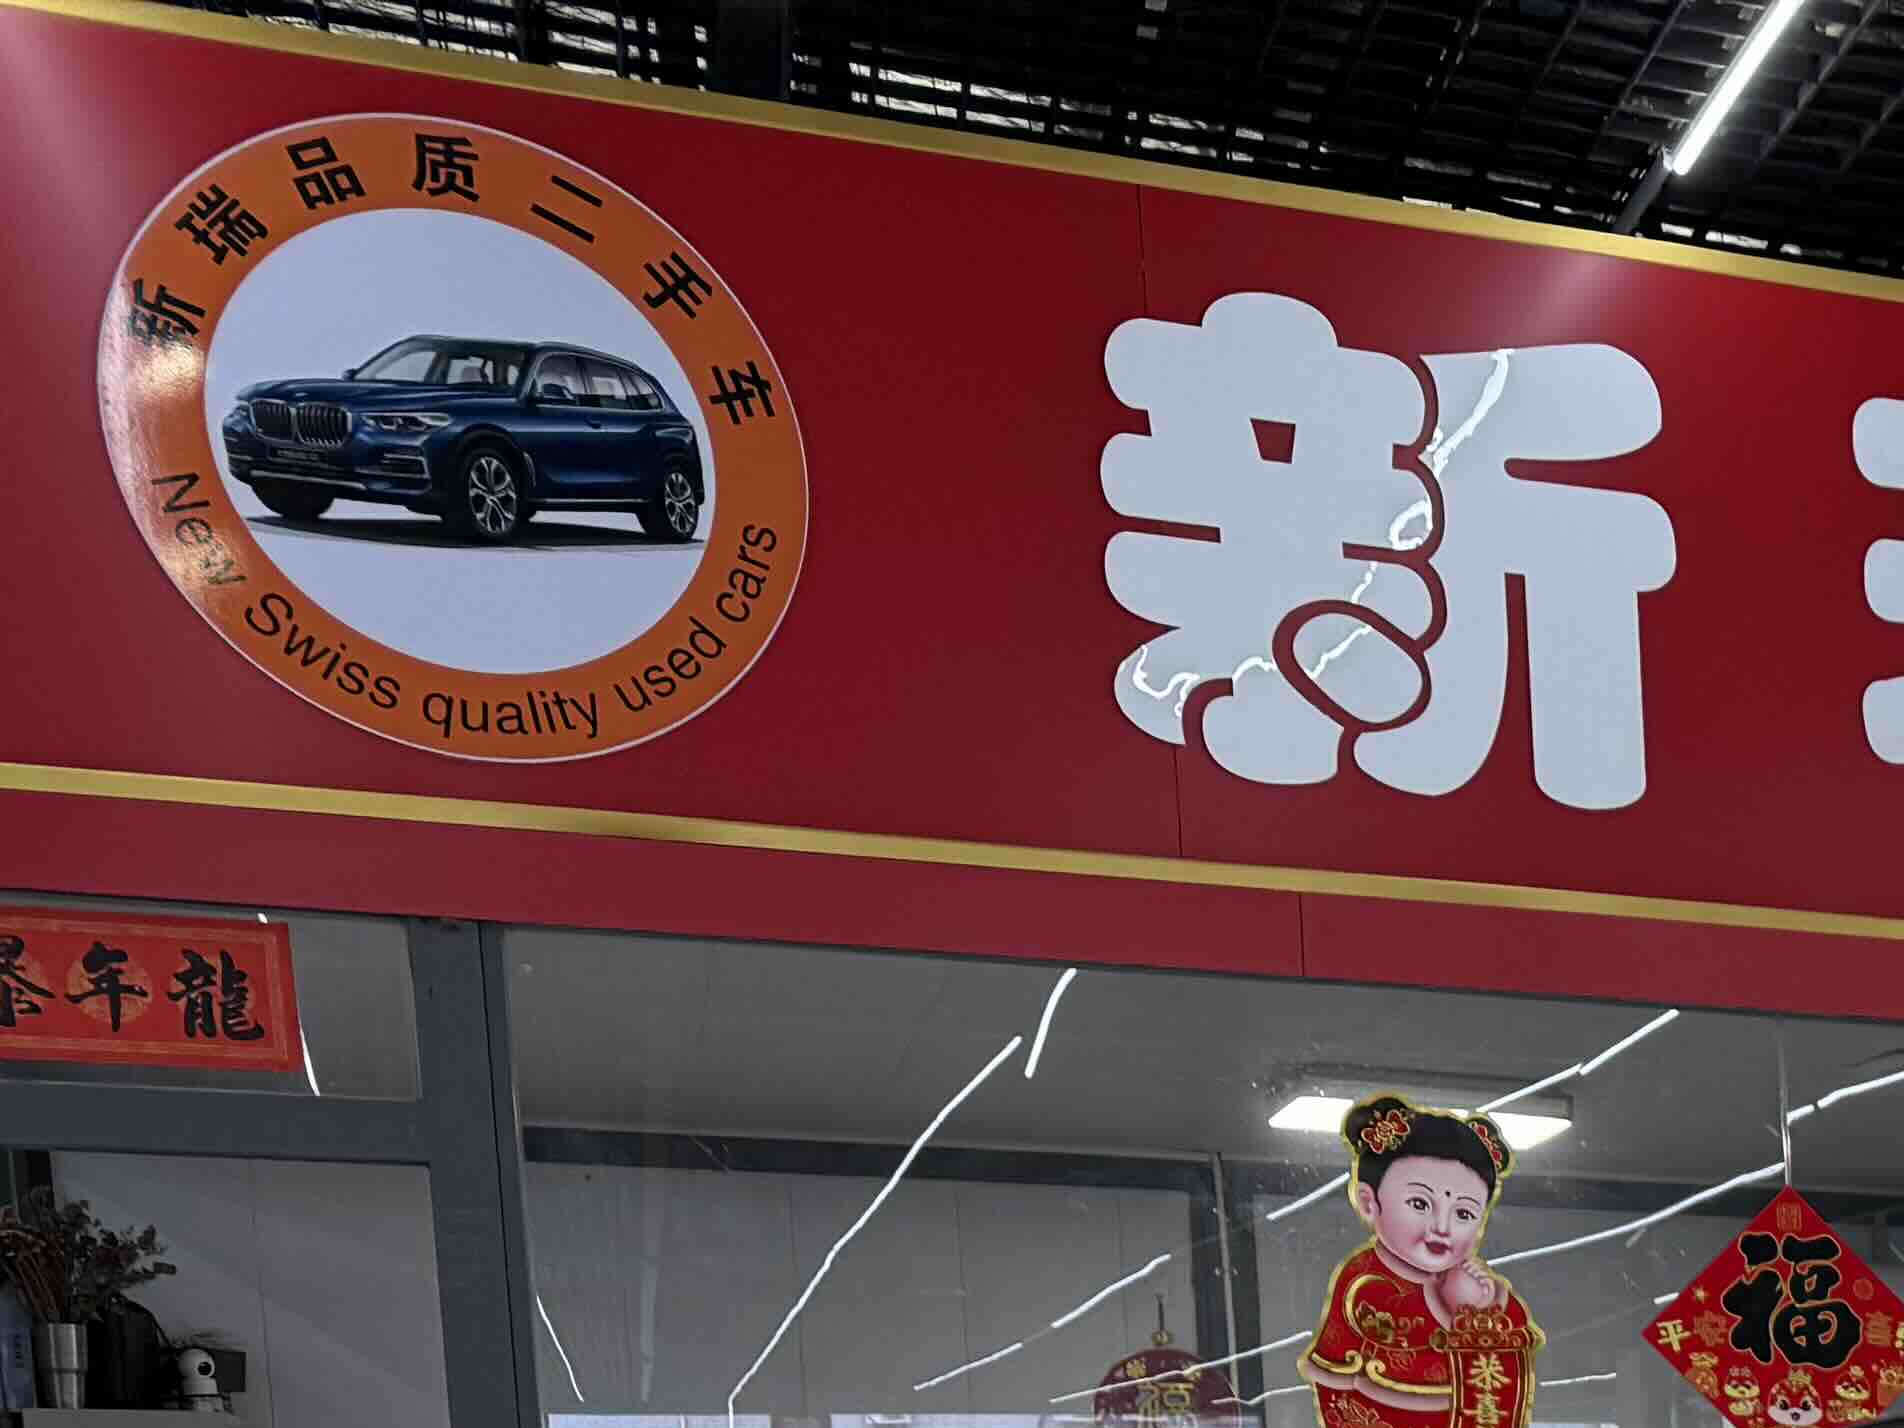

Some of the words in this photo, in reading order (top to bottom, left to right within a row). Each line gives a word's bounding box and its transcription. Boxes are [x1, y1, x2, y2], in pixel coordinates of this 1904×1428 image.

[129, 132, 776, 427] 新瑞品质二手车
[152, 471, 246, 589] New
[244, 591, 402, 709] Swiss
[422, 689, 600, 737] quality
[613, 617, 727, 713] used
[715, 522, 778, 625] cars
[1721, 1232, 1863, 1369] 福
